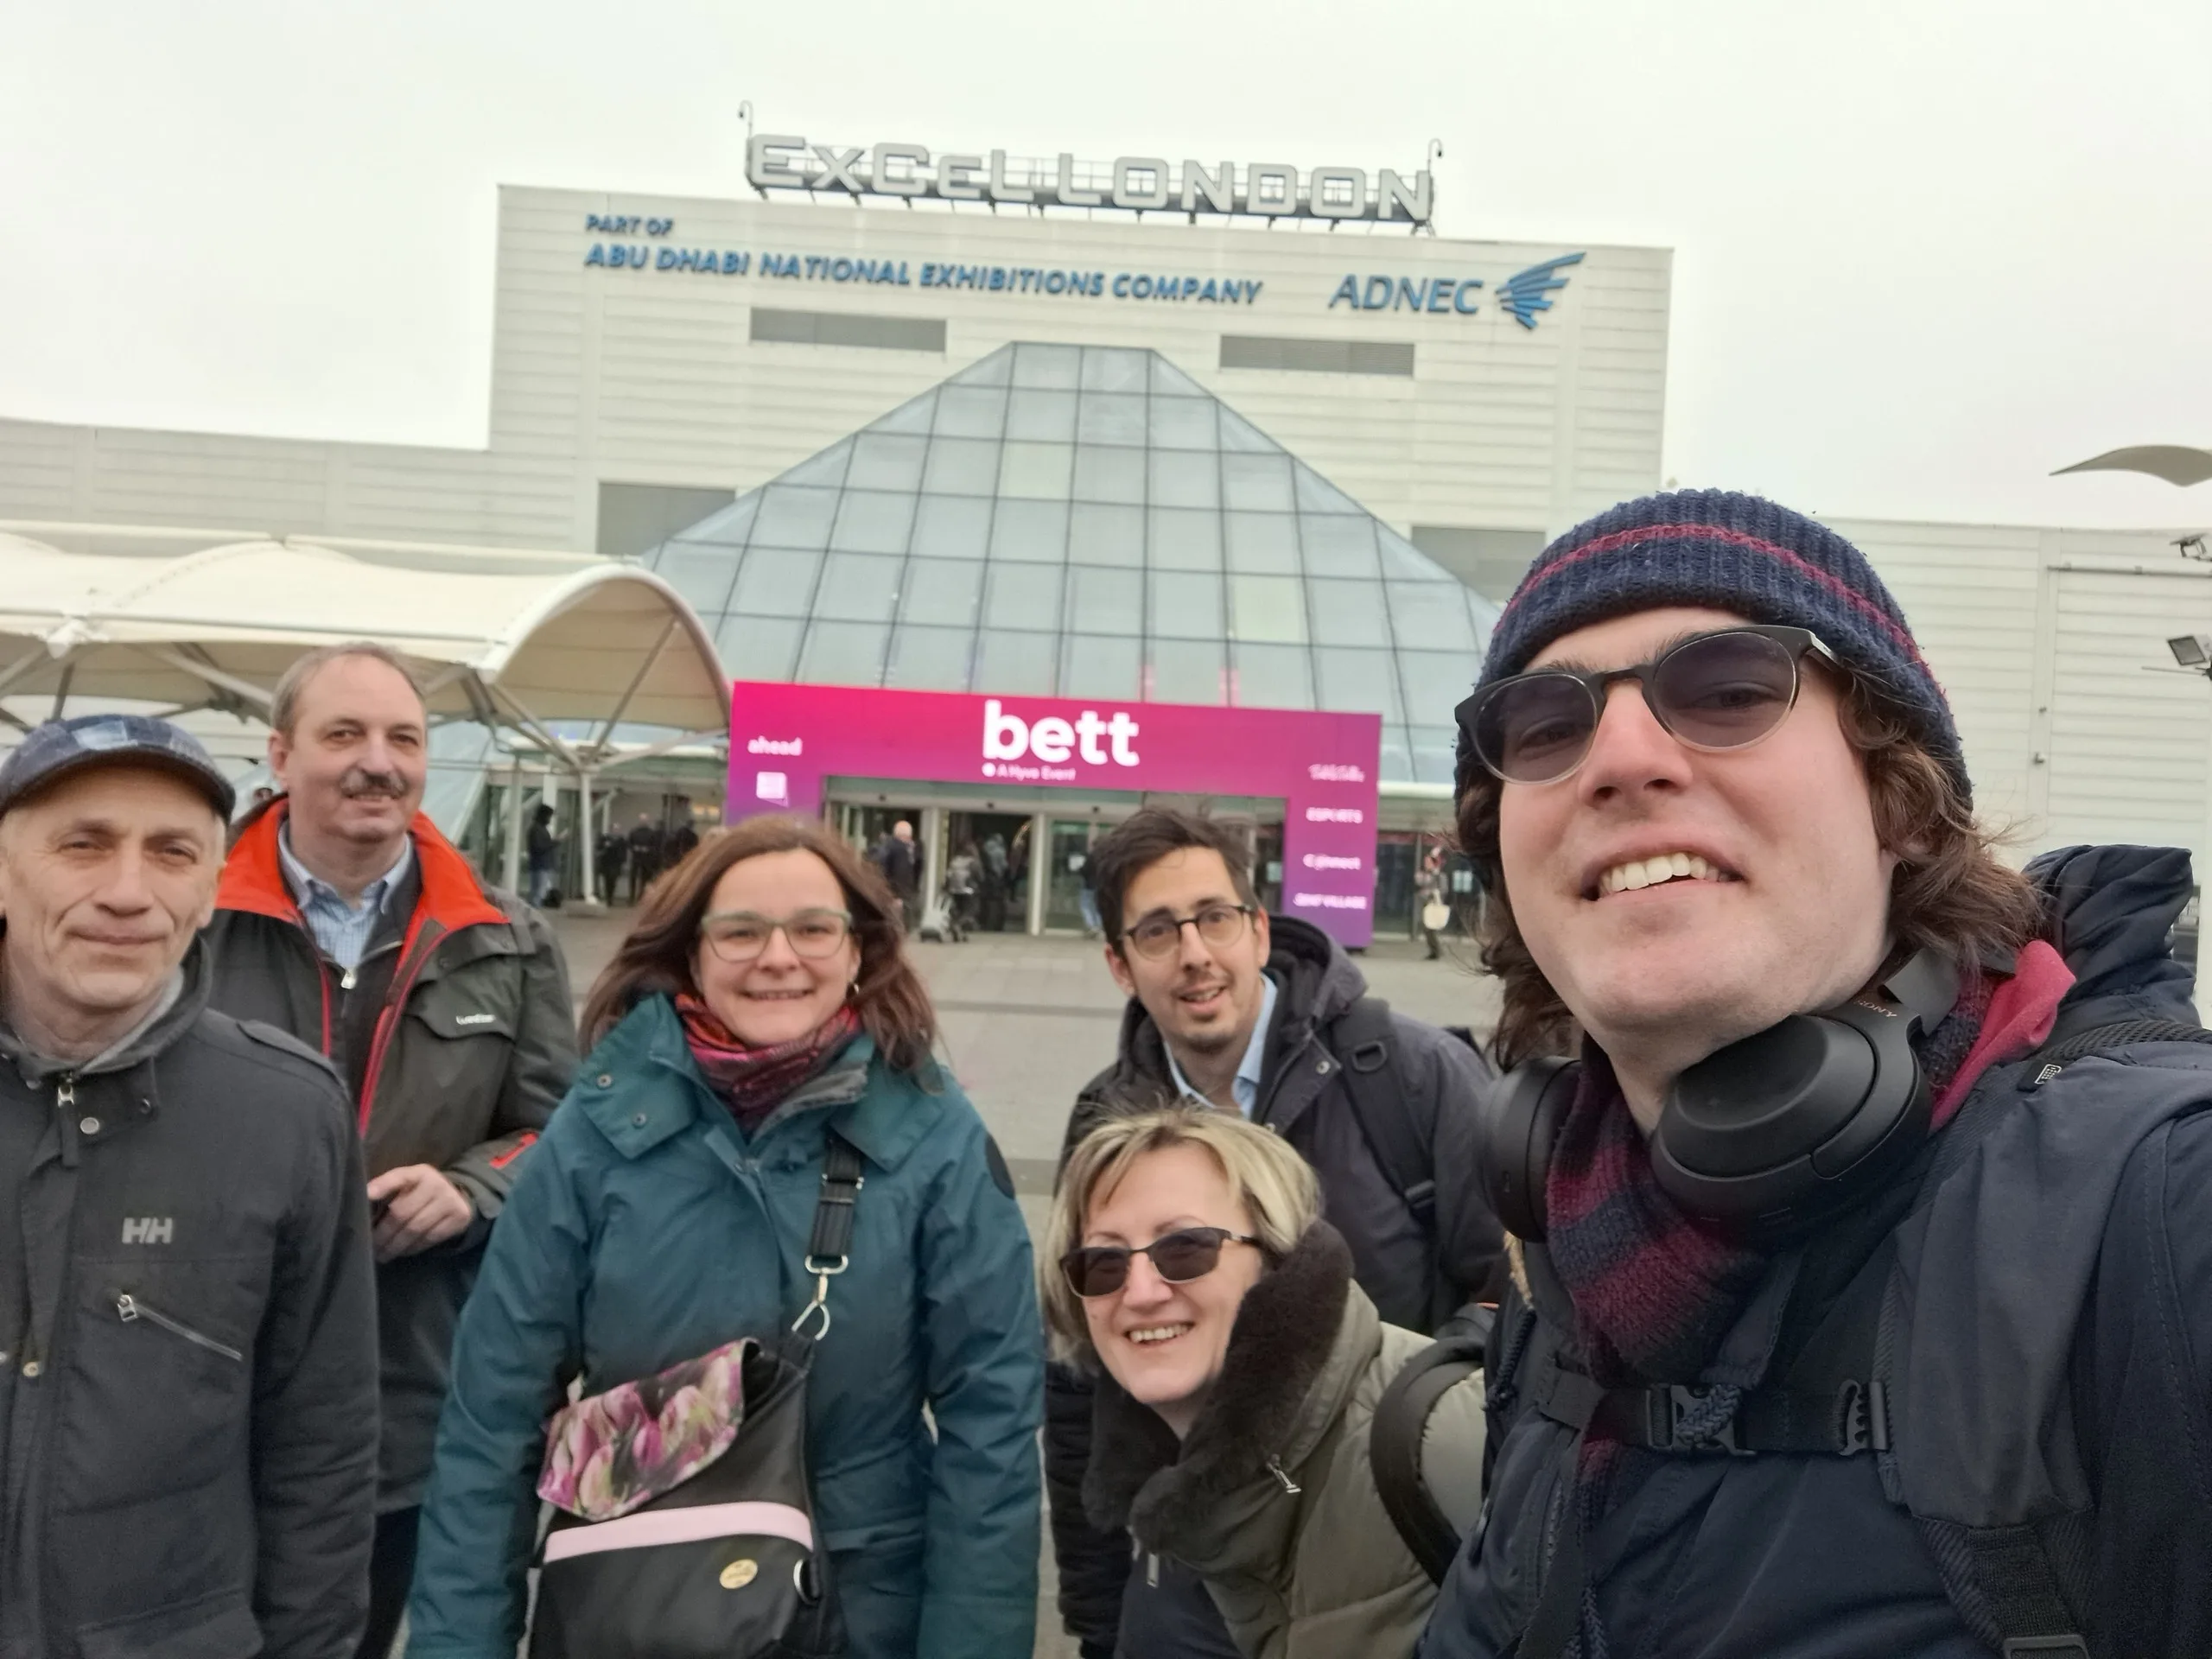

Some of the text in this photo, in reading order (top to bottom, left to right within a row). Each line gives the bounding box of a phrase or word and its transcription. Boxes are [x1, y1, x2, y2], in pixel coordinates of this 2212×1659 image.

[1056, 152, 1431, 221] LONDON
[584, 213, 675, 237] PART OF
[583, 243, 1264, 305] ABU DHABI NATIONAL EXHIBITIONS COMPANY
[1327, 273, 1484, 315] ADNEC
[982, 698, 1141, 767] bett
[995, 762, 1009, 778] A
[1040, 765, 1077, 781] Event
